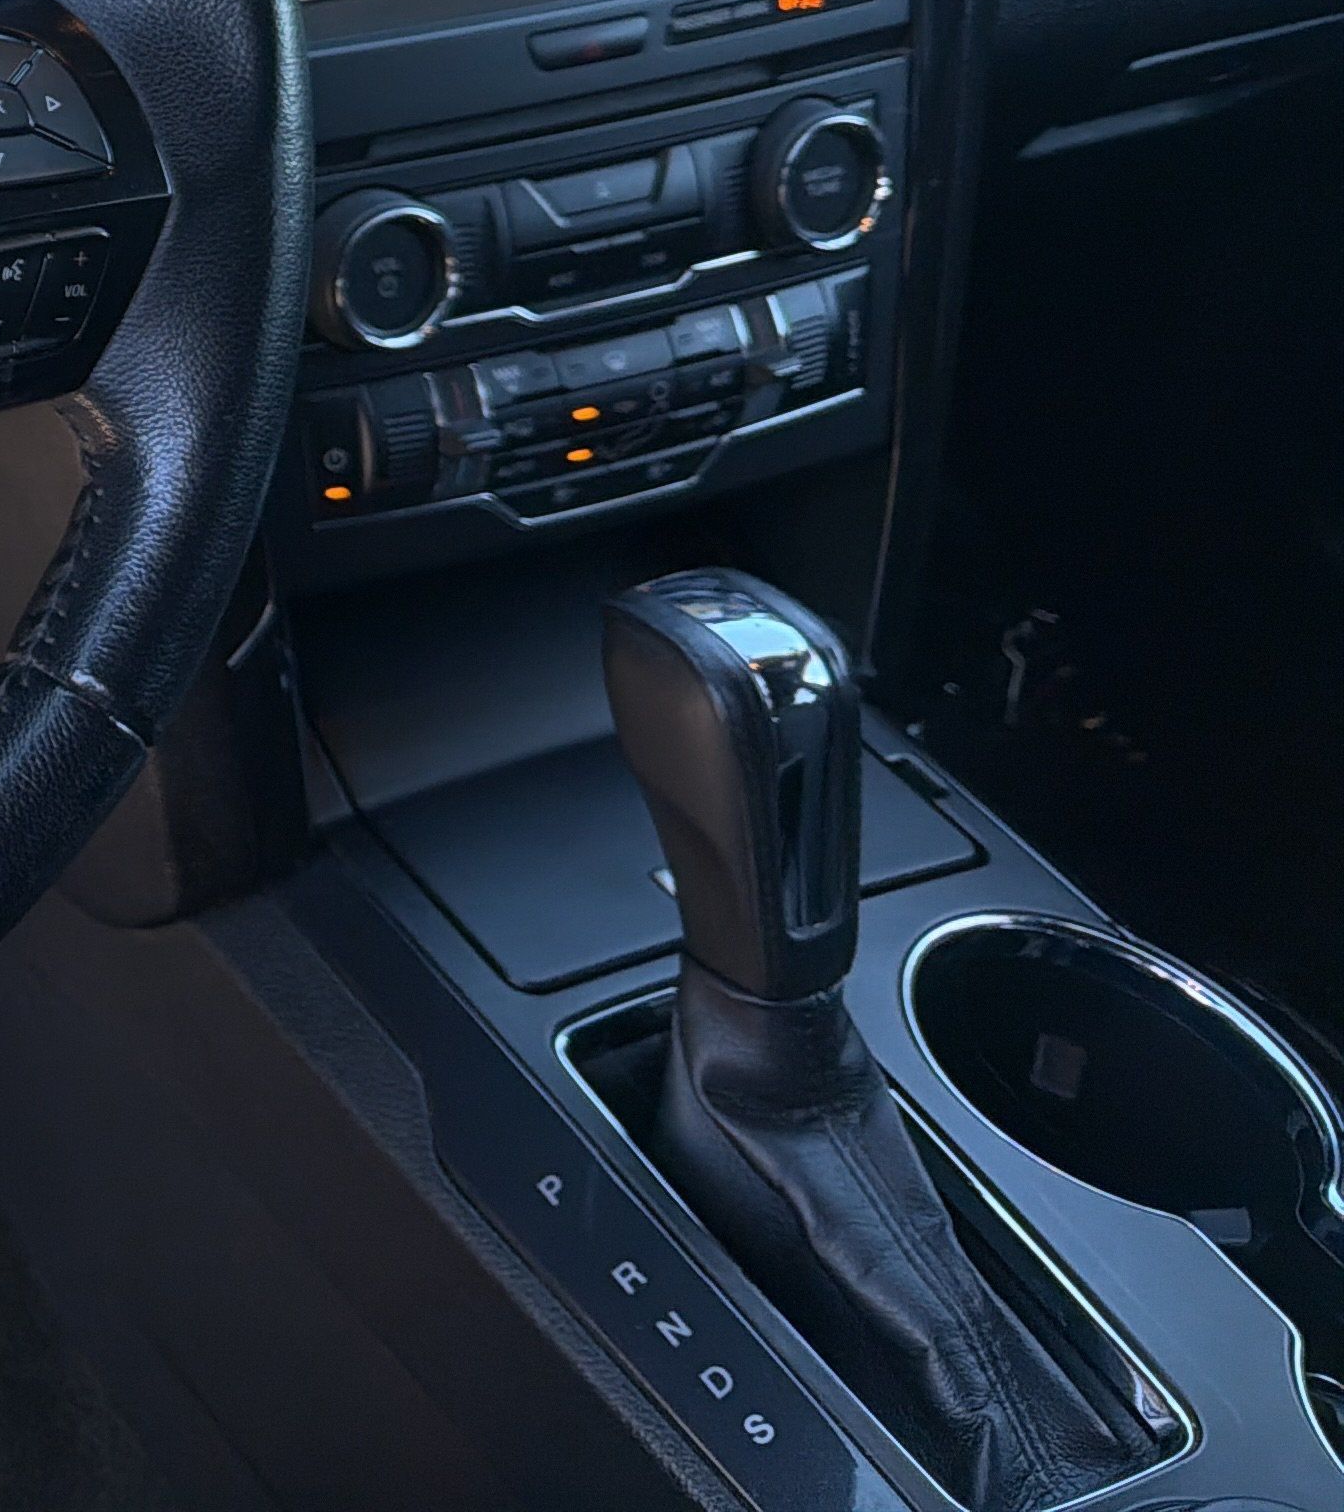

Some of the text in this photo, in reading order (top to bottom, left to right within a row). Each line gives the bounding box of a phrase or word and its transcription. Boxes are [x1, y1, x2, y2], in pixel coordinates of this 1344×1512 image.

[64, 284, 87, 298] VOL
[536, 1174, 562, 1207] P
[612, 1261, 648, 1295] R
[655, 1310, 693, 1348] N
[698, 1365, 734, 1400] D
[743, 1414, 775, 1444] S
